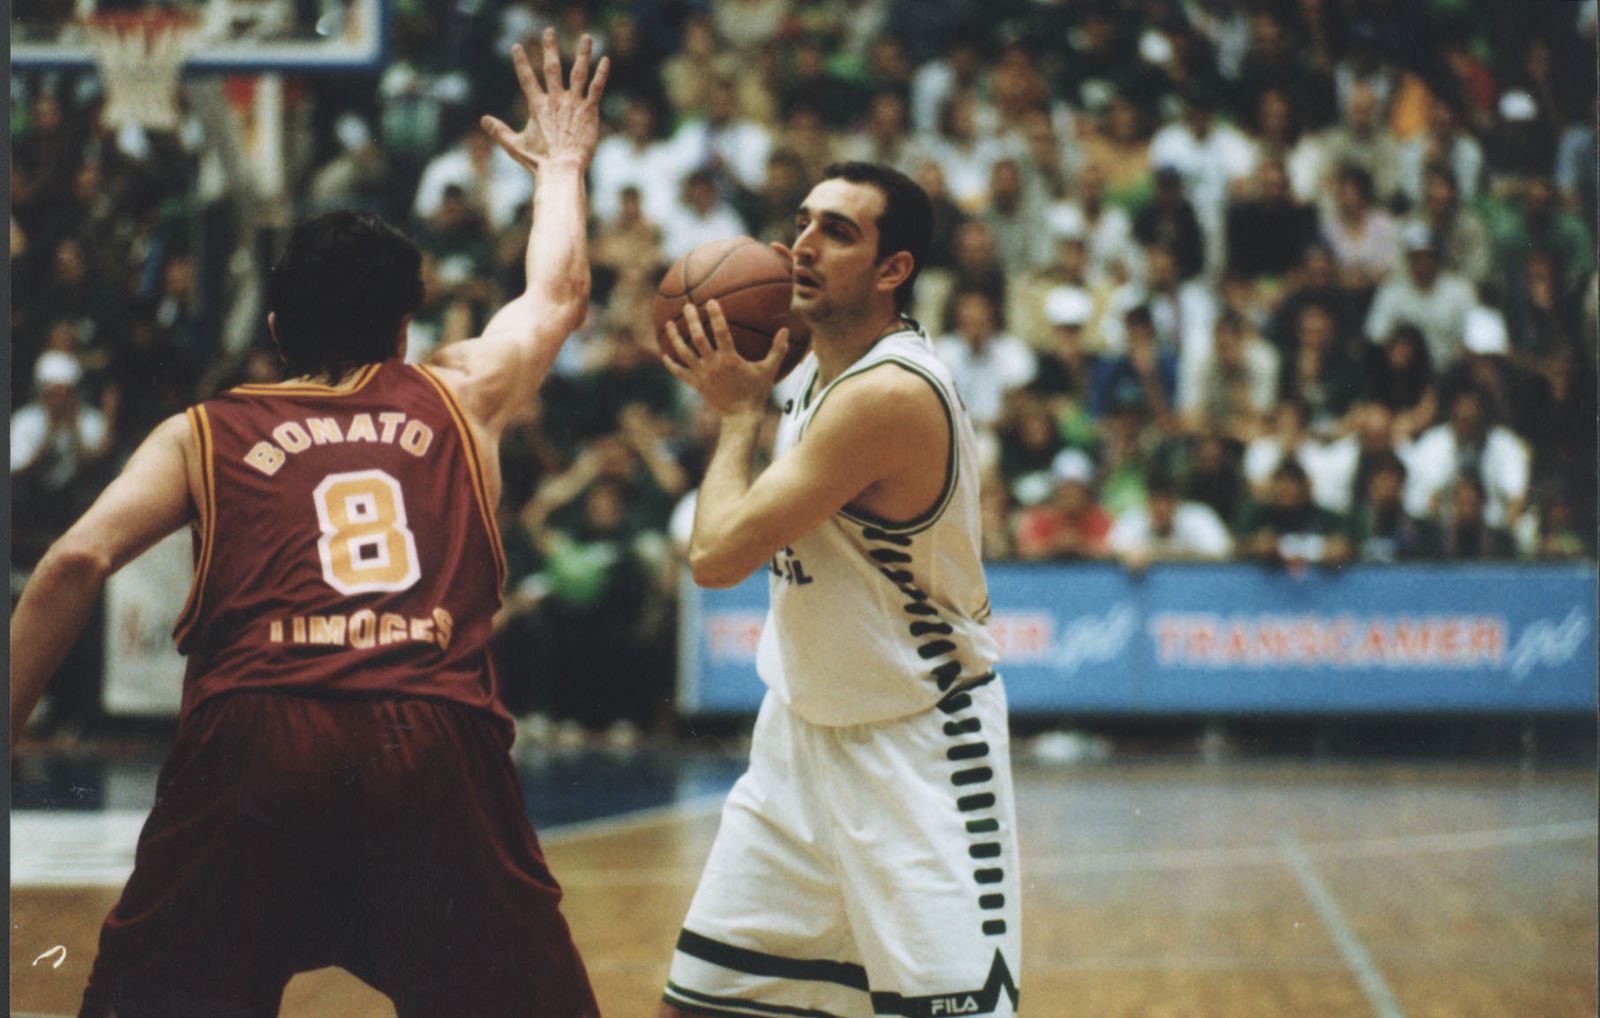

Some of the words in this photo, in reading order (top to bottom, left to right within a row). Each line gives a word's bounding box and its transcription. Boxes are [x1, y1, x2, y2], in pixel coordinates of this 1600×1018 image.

[243, 412, 434, 476] BONATO
[312, 469, 422, 597] 8
[931, 995, 979, 1015] FILA
